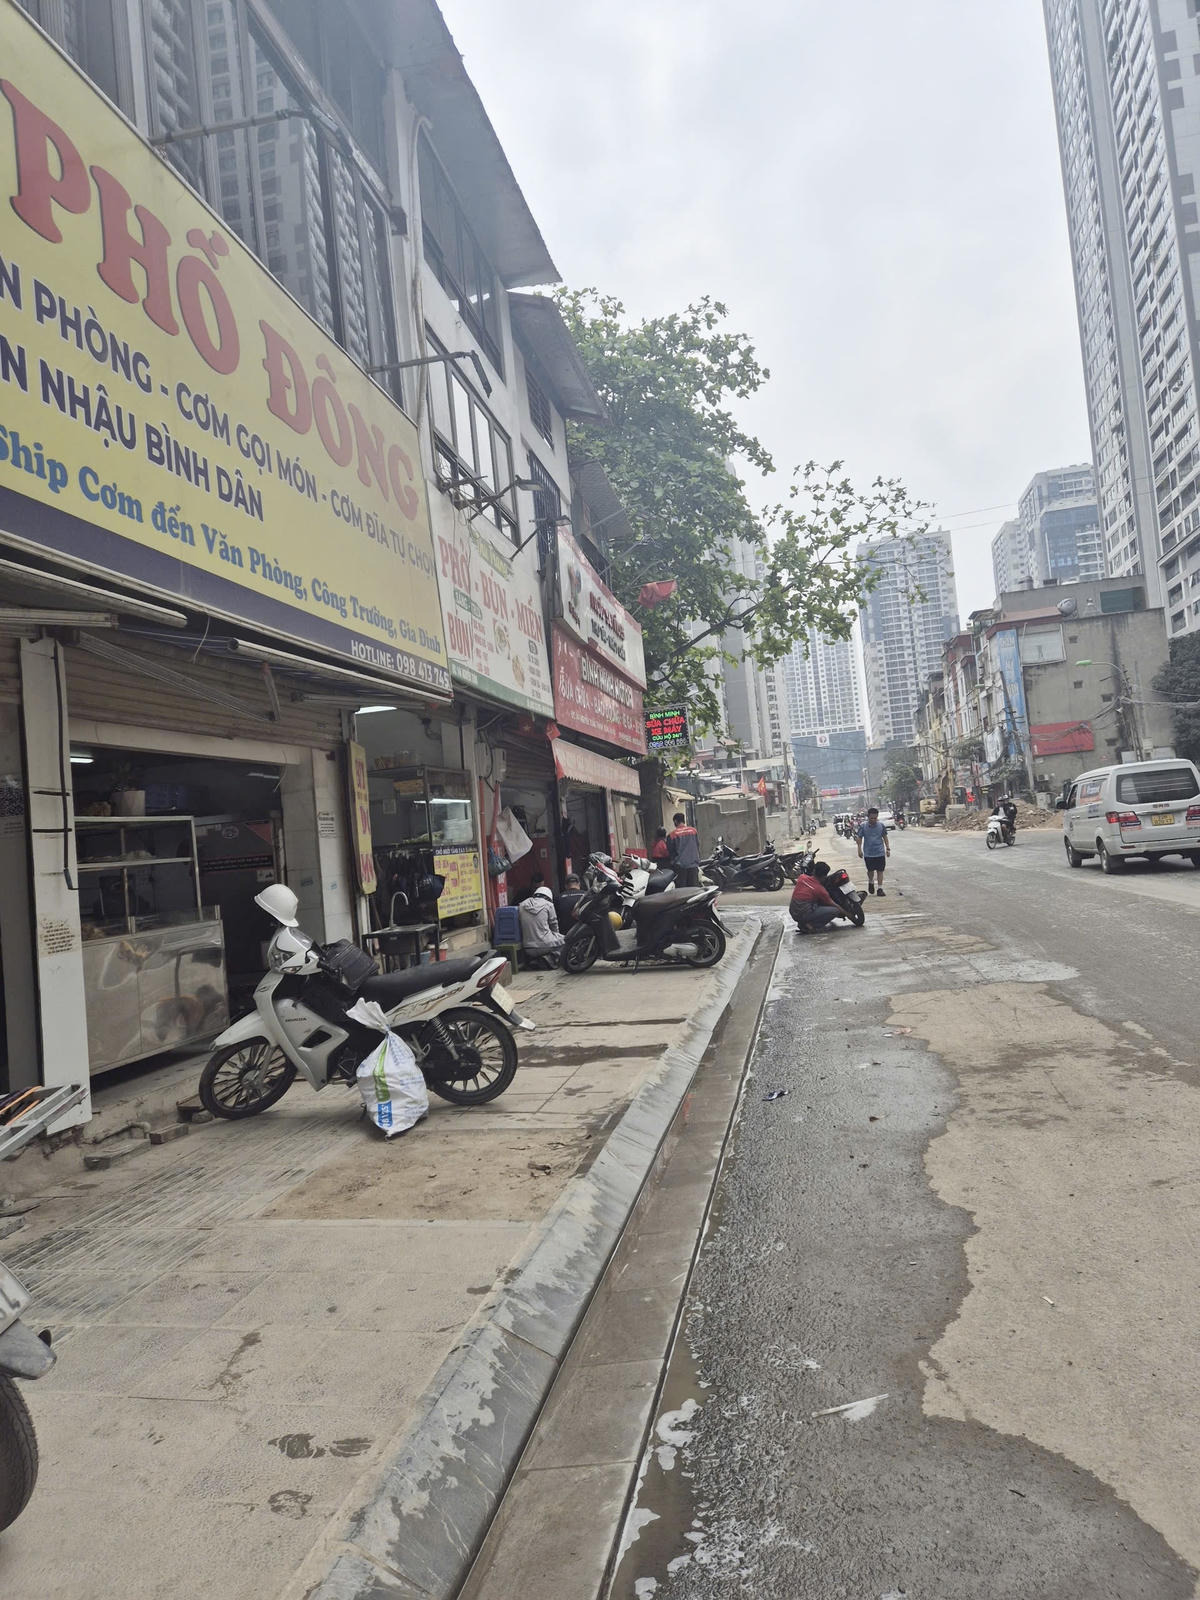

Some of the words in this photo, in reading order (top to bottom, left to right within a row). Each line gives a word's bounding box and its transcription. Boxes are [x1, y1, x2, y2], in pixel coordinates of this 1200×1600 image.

[0, 78, 240, 375] PHỐ
[259, 320, 420, 521] ĐÔNG
[34, 279, 152, 393] PHÒNG
[176, 382, 231, 447] CƠM
[236, 424, 272, 475] GỌI
[276, 450, 318, 502] MÓN
[330, 489, 363, 532] CƠM
[40, 358, 137, 450] NHẬU
[145, 422, 210, 493] BÌNH
[216, 465, 264, 522] DÂN
[78, 465, 144, 524] Cơm
[152, 500, 195, 547] đến
[201, 523, 244, 568] Văn
[248, 546, 307, 602] Phòng,
[311, 577, 348, 619] Công
[399, 618, 417, 643] Gia
[480, 568, 509, 622] BÚN
[351, 639, 395, 670] HOTLINE:
[396, 653, 416, 676] 098
